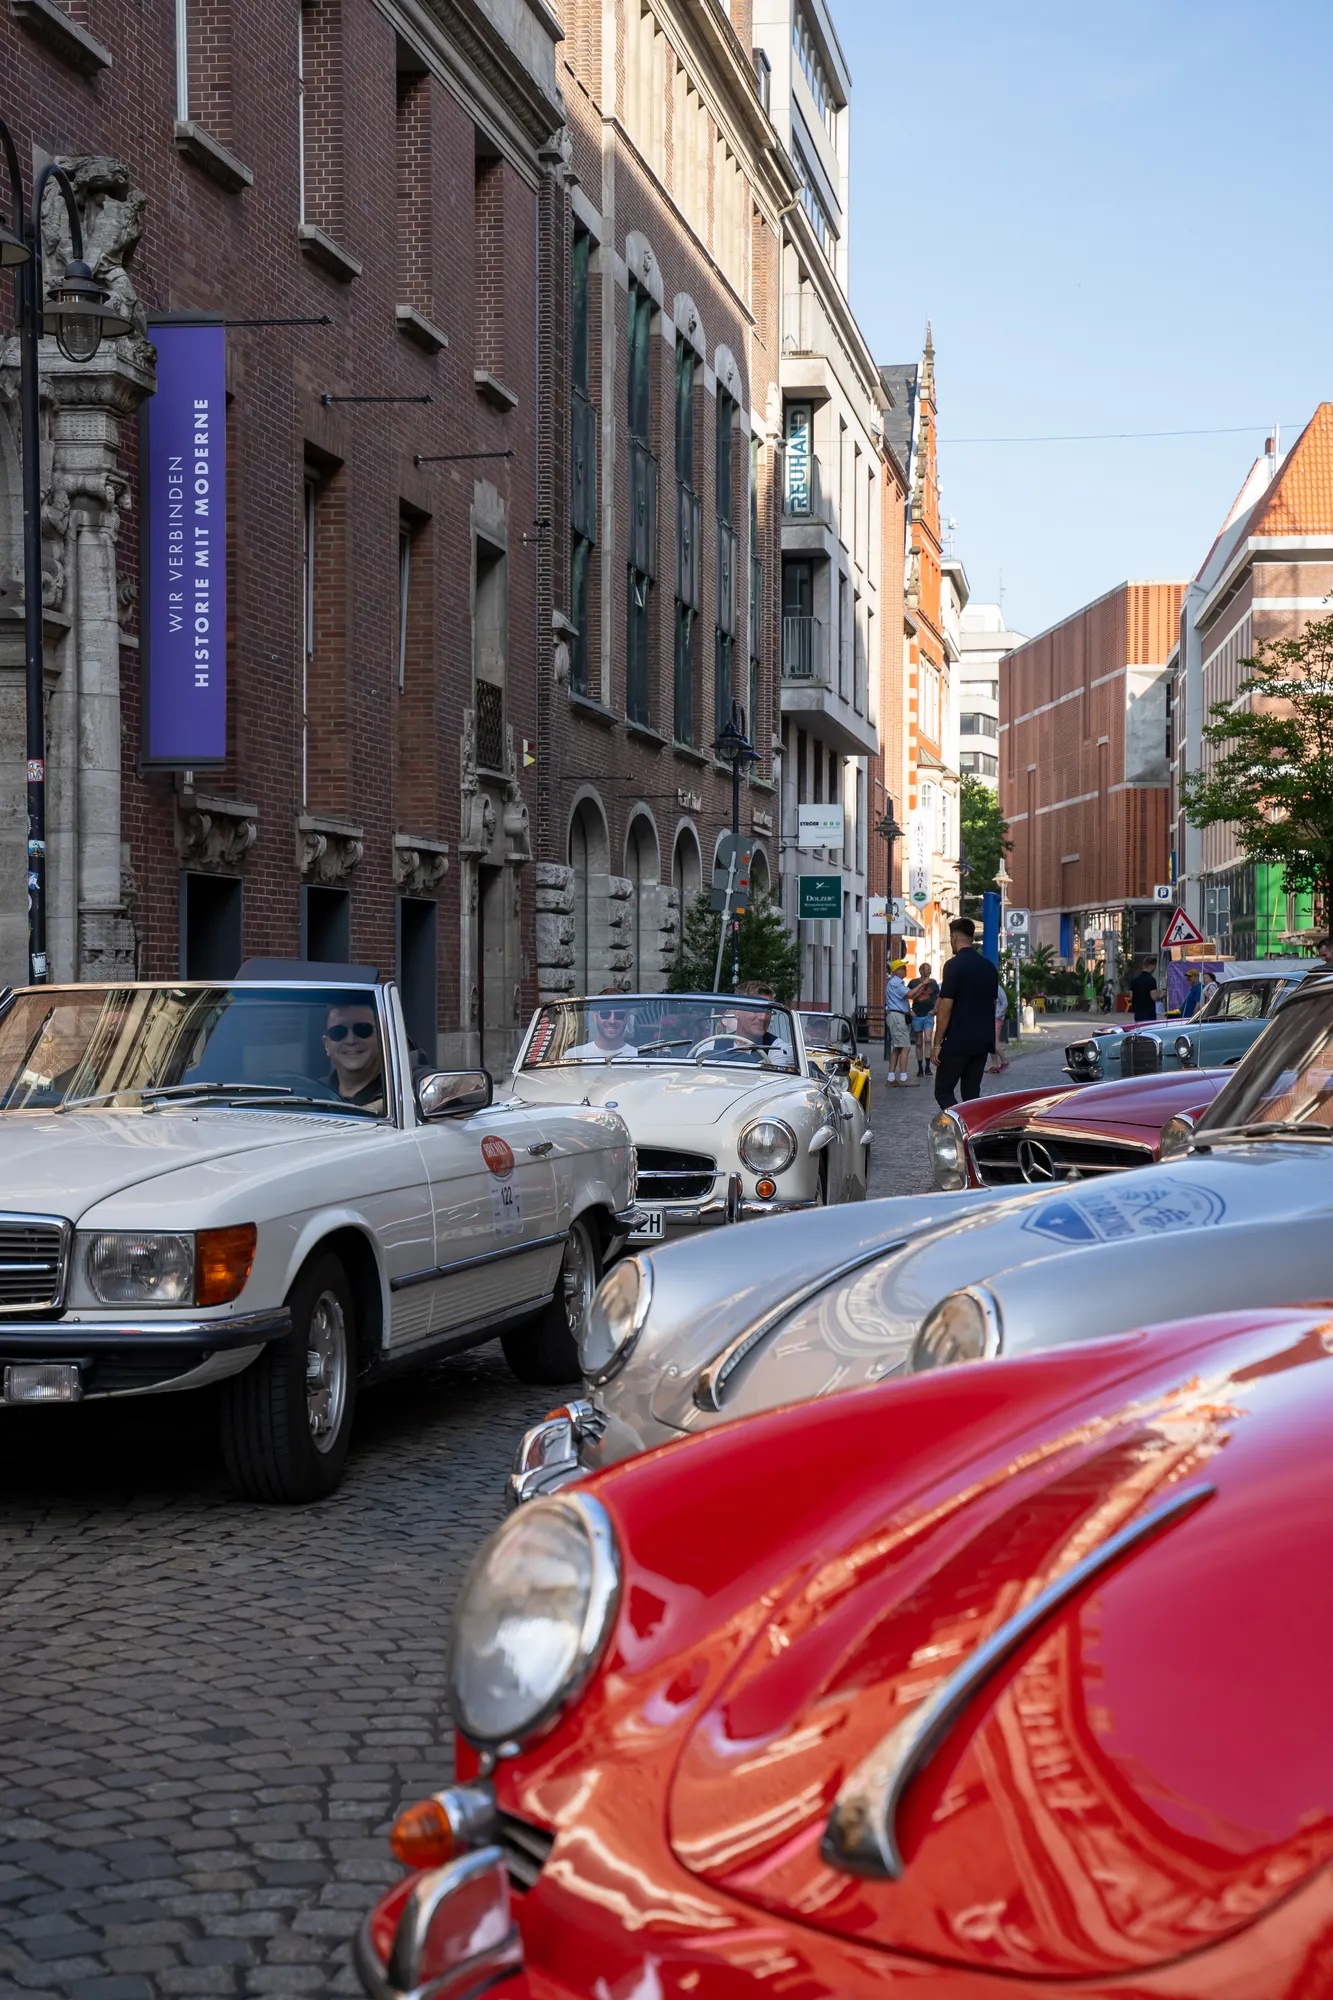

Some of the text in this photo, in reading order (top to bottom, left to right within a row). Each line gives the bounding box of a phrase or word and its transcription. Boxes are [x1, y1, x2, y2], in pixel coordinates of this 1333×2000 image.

[168, 456, 183, 633] WIR VERBINDEN
[193, 399, 210, 687] HISTORIE MIT MODERNE
[501, 1186, 513, 1206] 122
